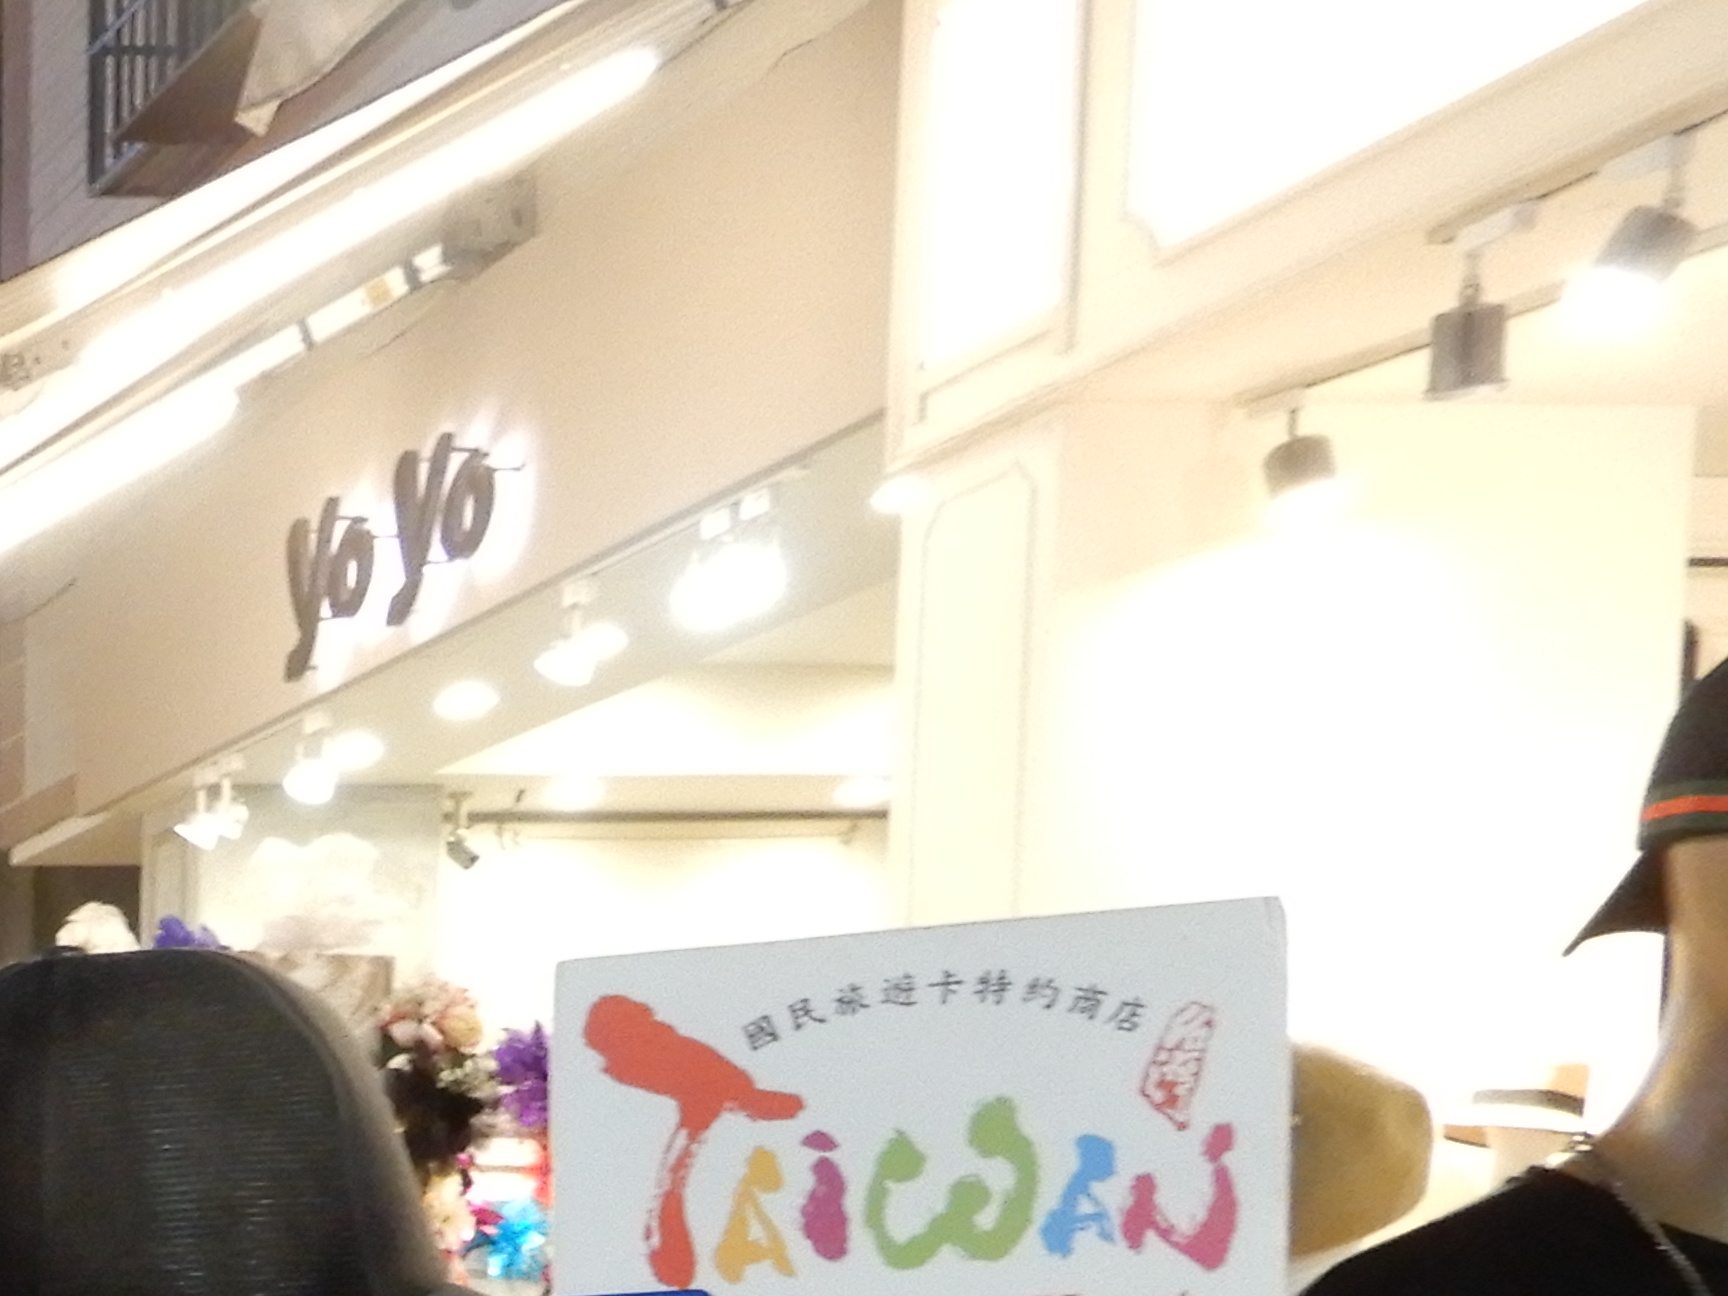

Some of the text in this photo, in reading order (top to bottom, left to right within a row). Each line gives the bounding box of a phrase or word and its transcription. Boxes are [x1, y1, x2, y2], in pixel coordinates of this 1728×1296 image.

[740, 968, 1148, 1052] 國民旅遊卡特約商店
